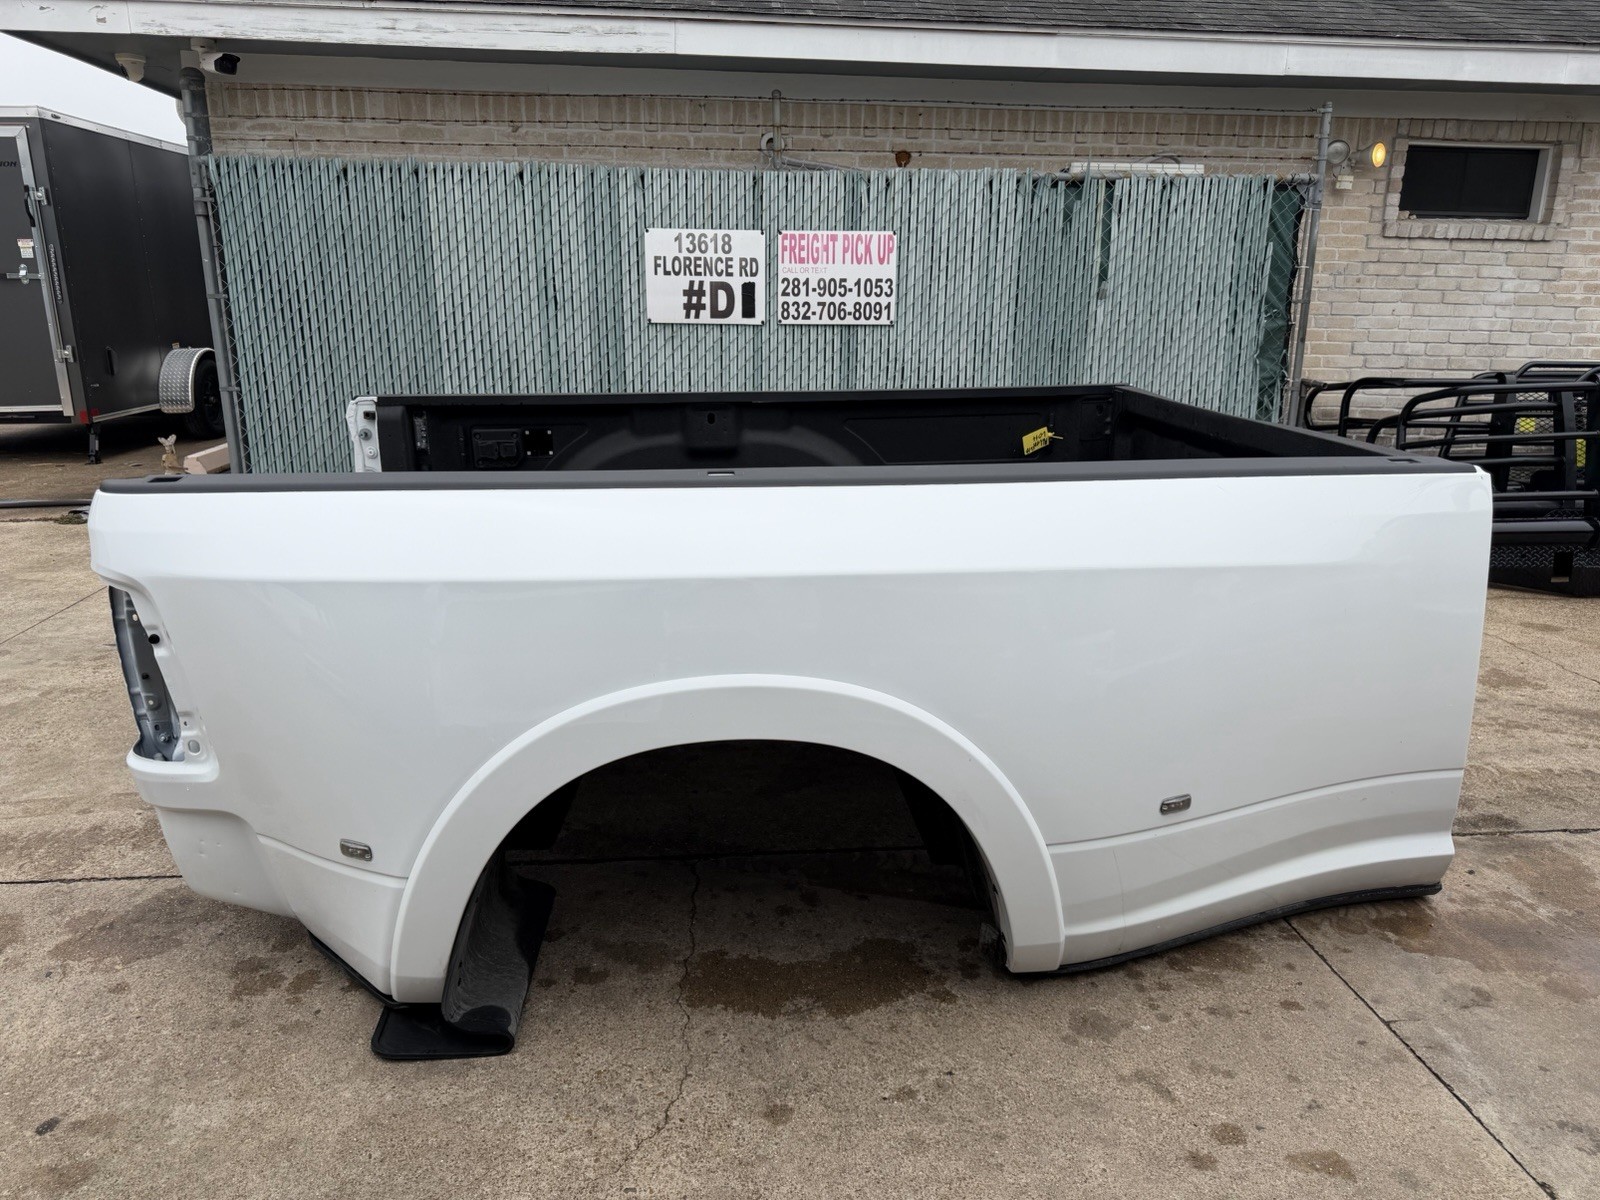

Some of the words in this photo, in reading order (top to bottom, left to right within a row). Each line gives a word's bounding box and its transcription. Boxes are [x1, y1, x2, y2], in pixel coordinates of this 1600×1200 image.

[674, 232, 732, 254] 13618
[781, 233, 838, 265] FREIGHT
[842, 233, 873, 265] PICK
[877, 234, 895, 265] UP
[653, 255, 734, 277] FLORENCE
[739, 257, 759, 277] RD
[780, 277, 894, 298] 281-905-1053
[780, 300, 892, 321] 832-706-8091
